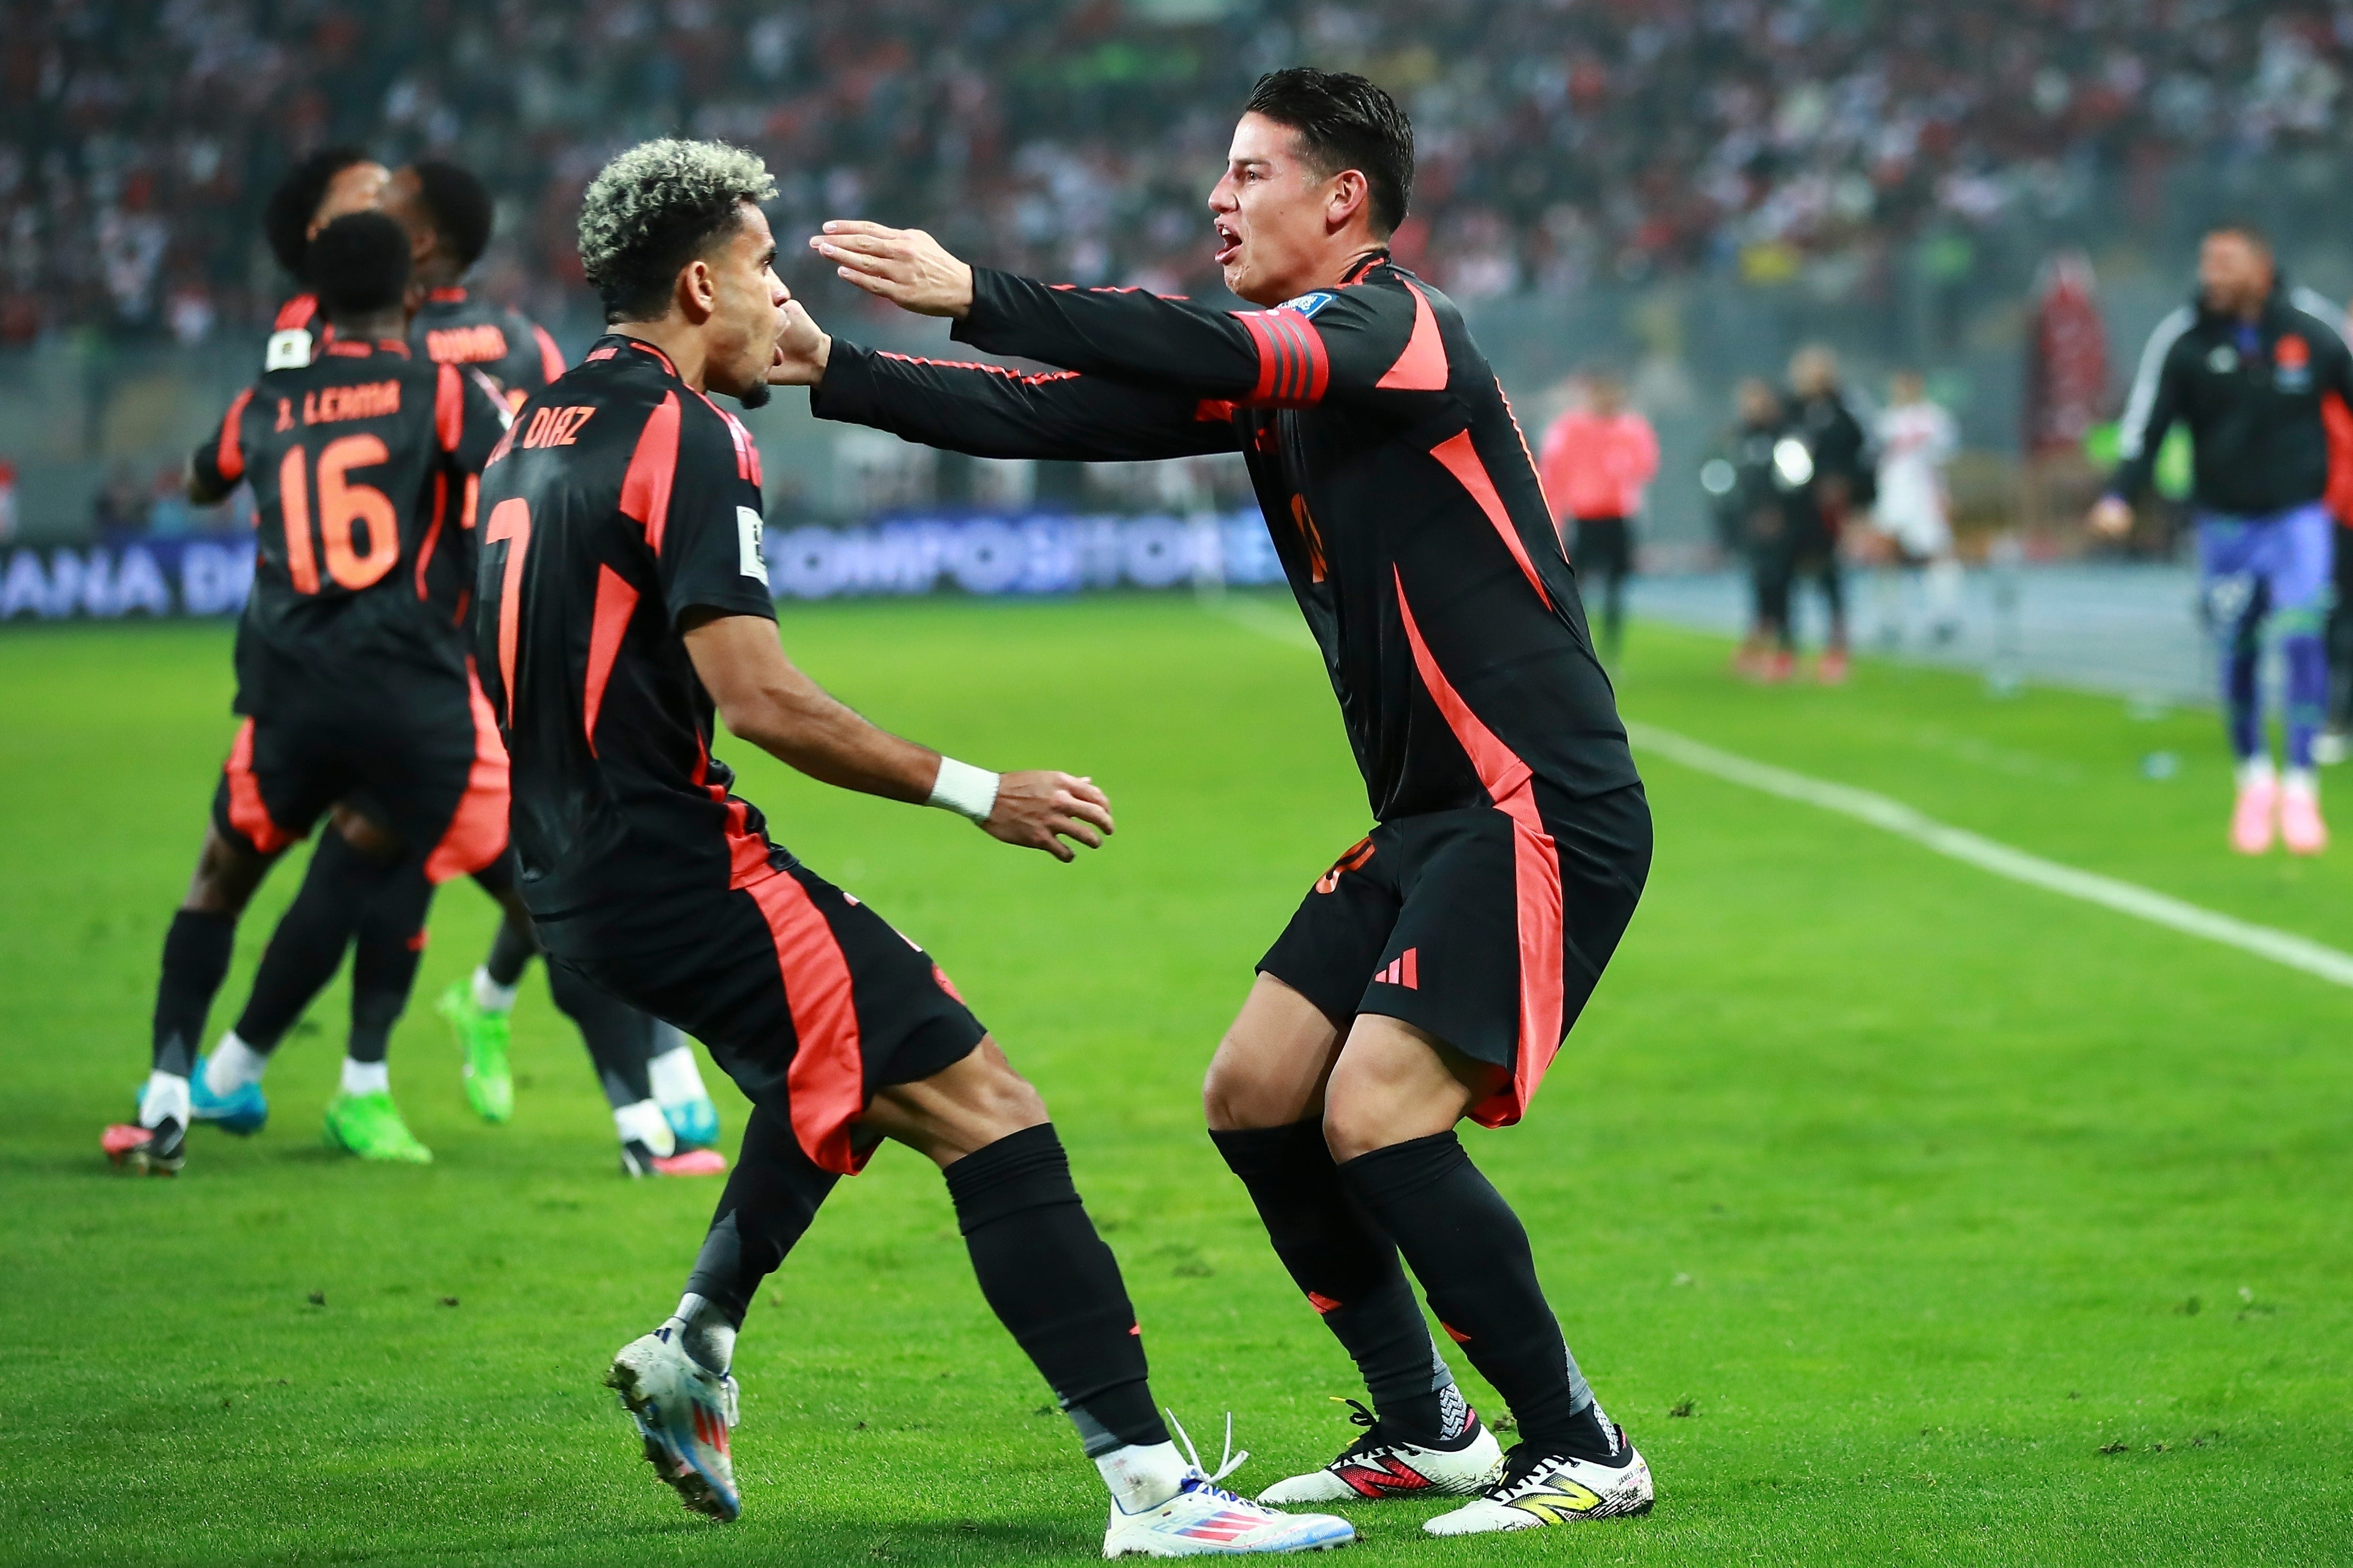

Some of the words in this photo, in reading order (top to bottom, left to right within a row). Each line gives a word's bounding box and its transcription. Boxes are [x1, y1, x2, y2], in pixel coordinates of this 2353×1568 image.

[523, 406, 597, 449] DIAZ
[279, 433, 401, 595] 16
[486, 497, 531, 730] 7
[1618, 1471, 1634, 1486] JAMES
